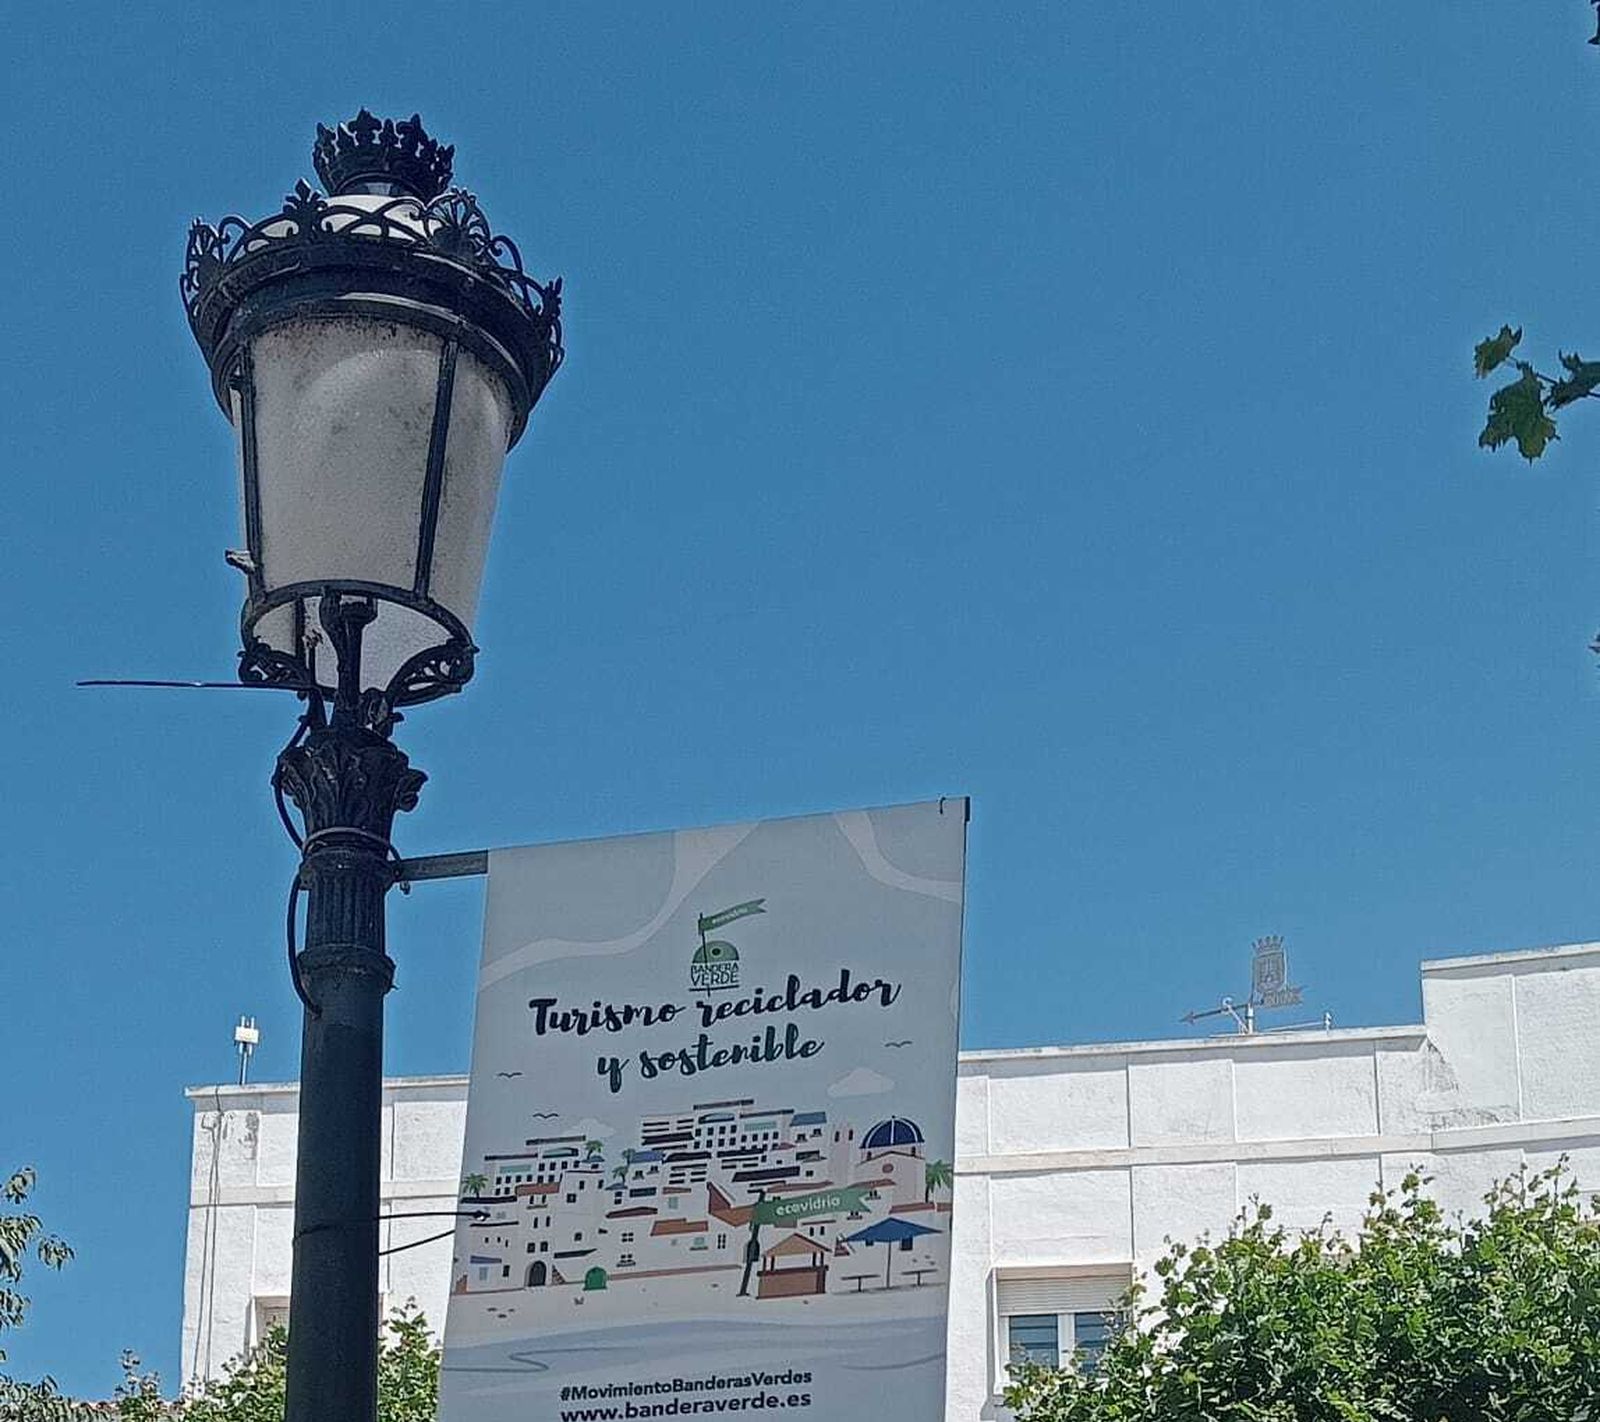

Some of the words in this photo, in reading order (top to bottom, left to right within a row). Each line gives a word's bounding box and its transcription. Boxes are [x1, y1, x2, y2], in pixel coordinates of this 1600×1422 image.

[691, 971, 739, 986] VERDE
[529, 998, 686, 1036] Turismo
[696, 969, 901, 1028] reciclador
[597, 1054, 629, 1093] y
[640, 1023, 825, 1079] sostenible
[775, 1196, 840, 1216] ecovidrio
[560, 1369, 812, 1402] #MovimientoBanderasVerdes
[560, 1391, 812, 1422] www.banderaverde.es
